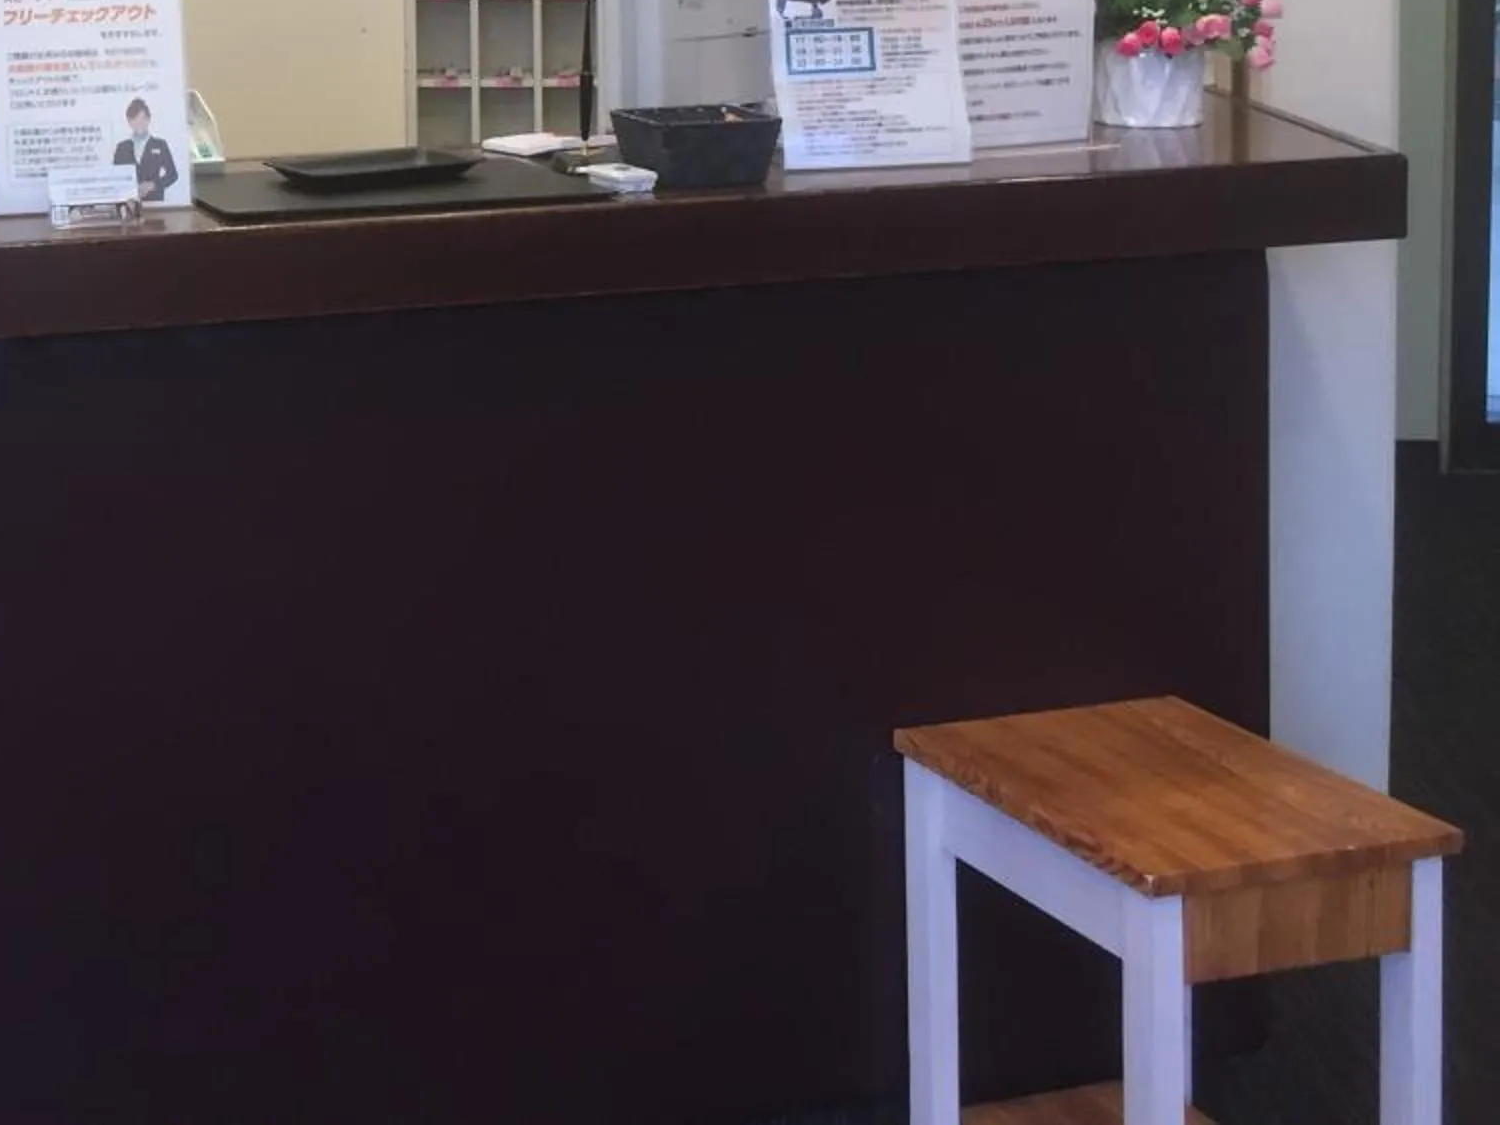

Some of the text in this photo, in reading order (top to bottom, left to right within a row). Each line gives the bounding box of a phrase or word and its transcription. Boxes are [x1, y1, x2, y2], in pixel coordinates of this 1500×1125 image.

[3, 4, 157, 26] フリーチェックアウト
